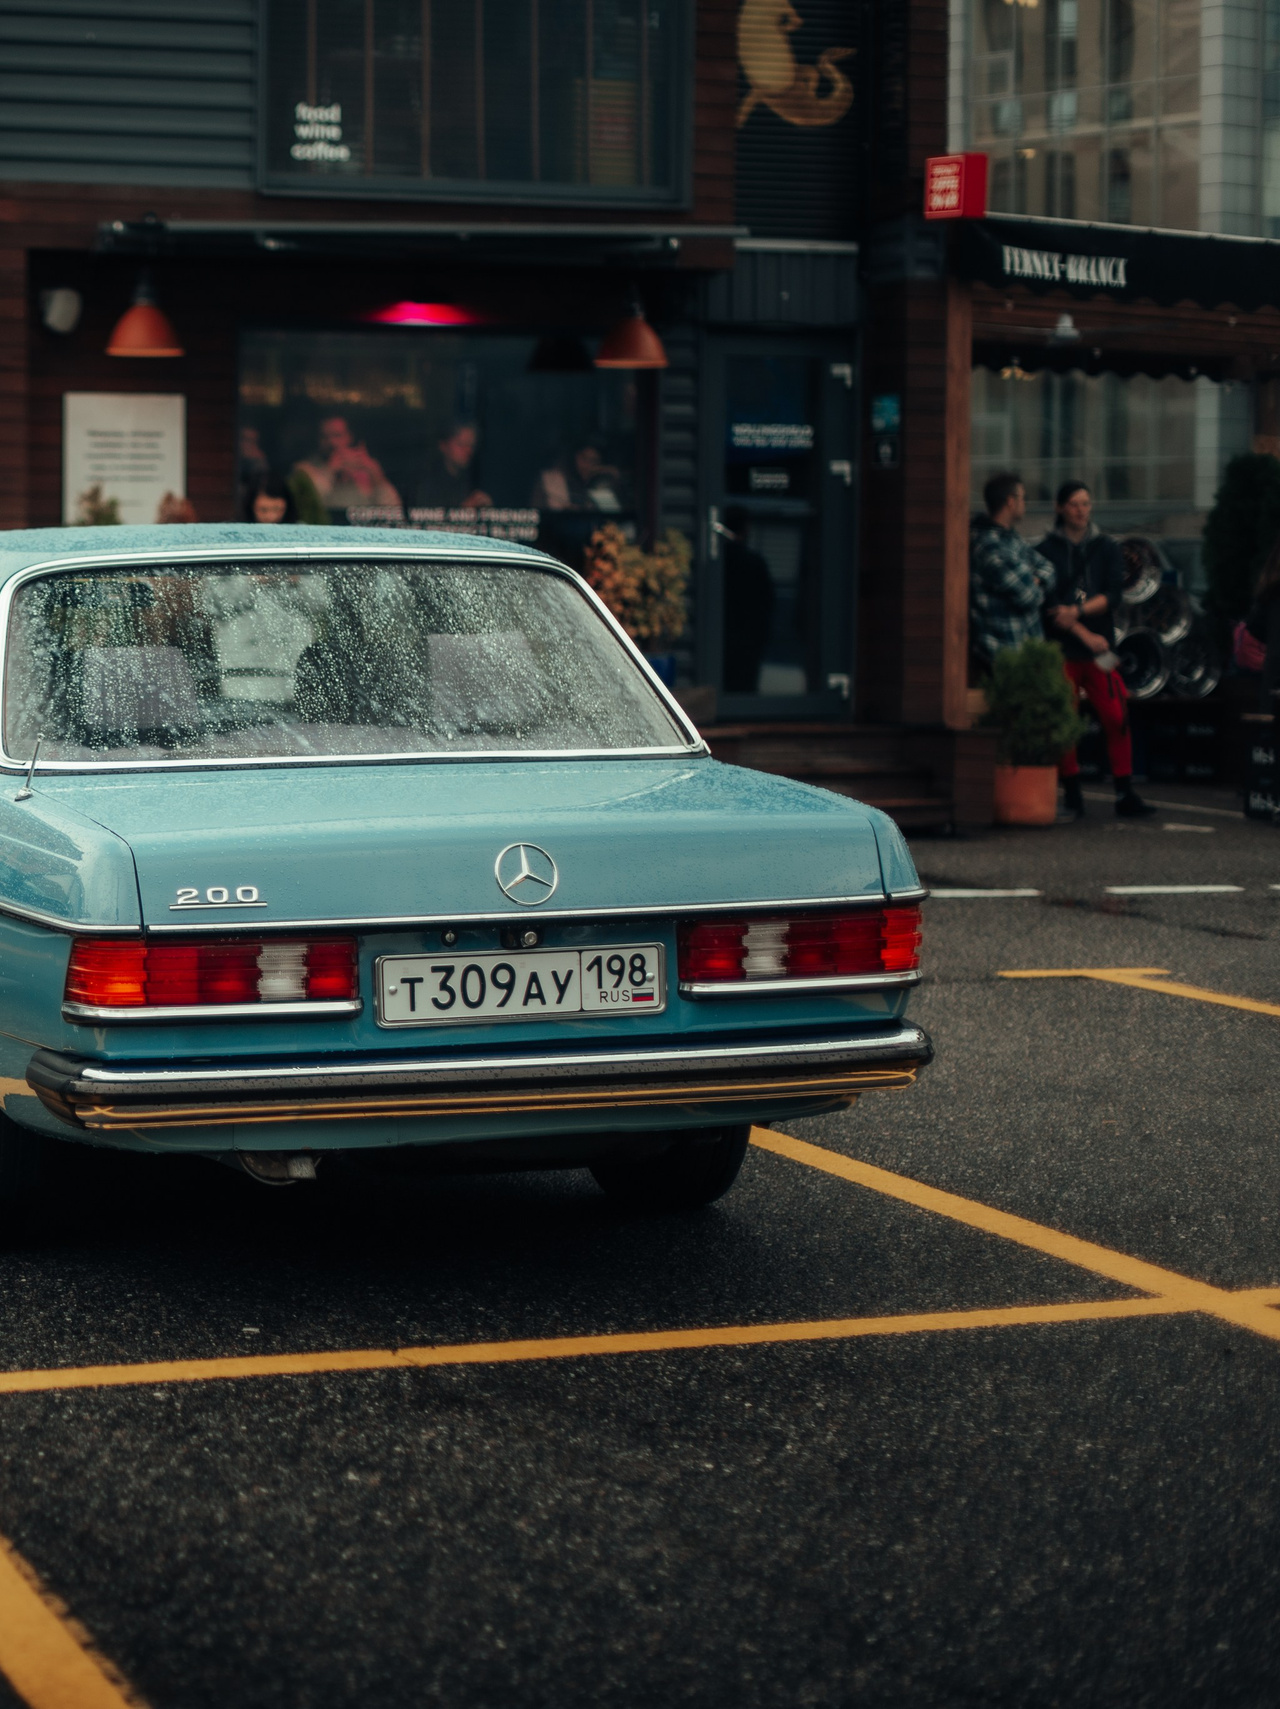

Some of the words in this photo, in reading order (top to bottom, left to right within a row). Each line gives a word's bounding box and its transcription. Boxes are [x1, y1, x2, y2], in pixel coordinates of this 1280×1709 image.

[295, 102, 341, 122] food
[294, 123, 342, 141] wine
[290, 142, 350, 161] coffee
[409, 506, 445, 522] WINE
[448, 507, 478, 522] AND
[479, 507, 540, 524] FRIENDS
[176, 886, 259, 905] 200
[586, 953, 647, 989] 198
[599, 989, 631, 1004] RUS
